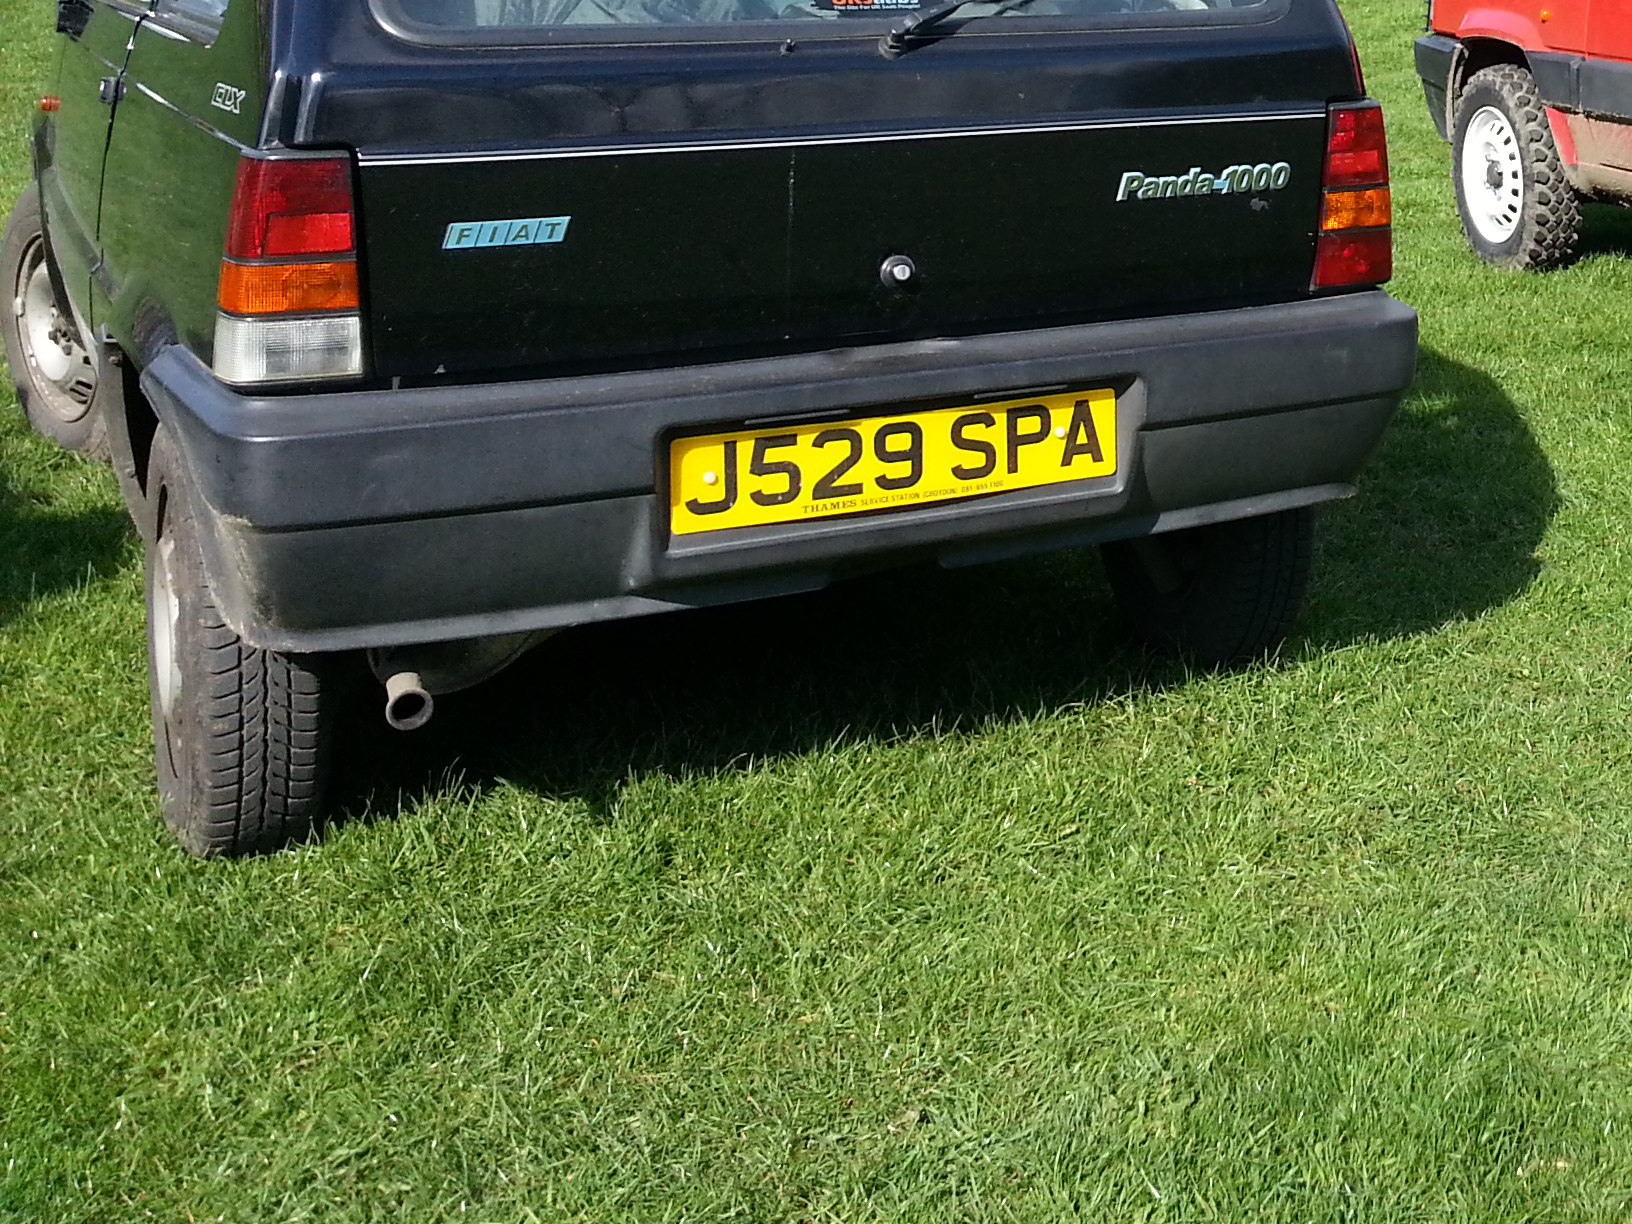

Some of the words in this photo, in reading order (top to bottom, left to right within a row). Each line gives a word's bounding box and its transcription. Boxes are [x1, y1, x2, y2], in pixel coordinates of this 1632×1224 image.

[211, 82, 246, 114] CLX
[455, 222, 562, 245] FIAT
[684, 421, 923, 515] J529
[951, 399, 1104, 480] SPA
[802, 499, 857, 513] THAMES
[861, 494, 889, 506] SERVICE
[891, 490, 920, 502] STATION
